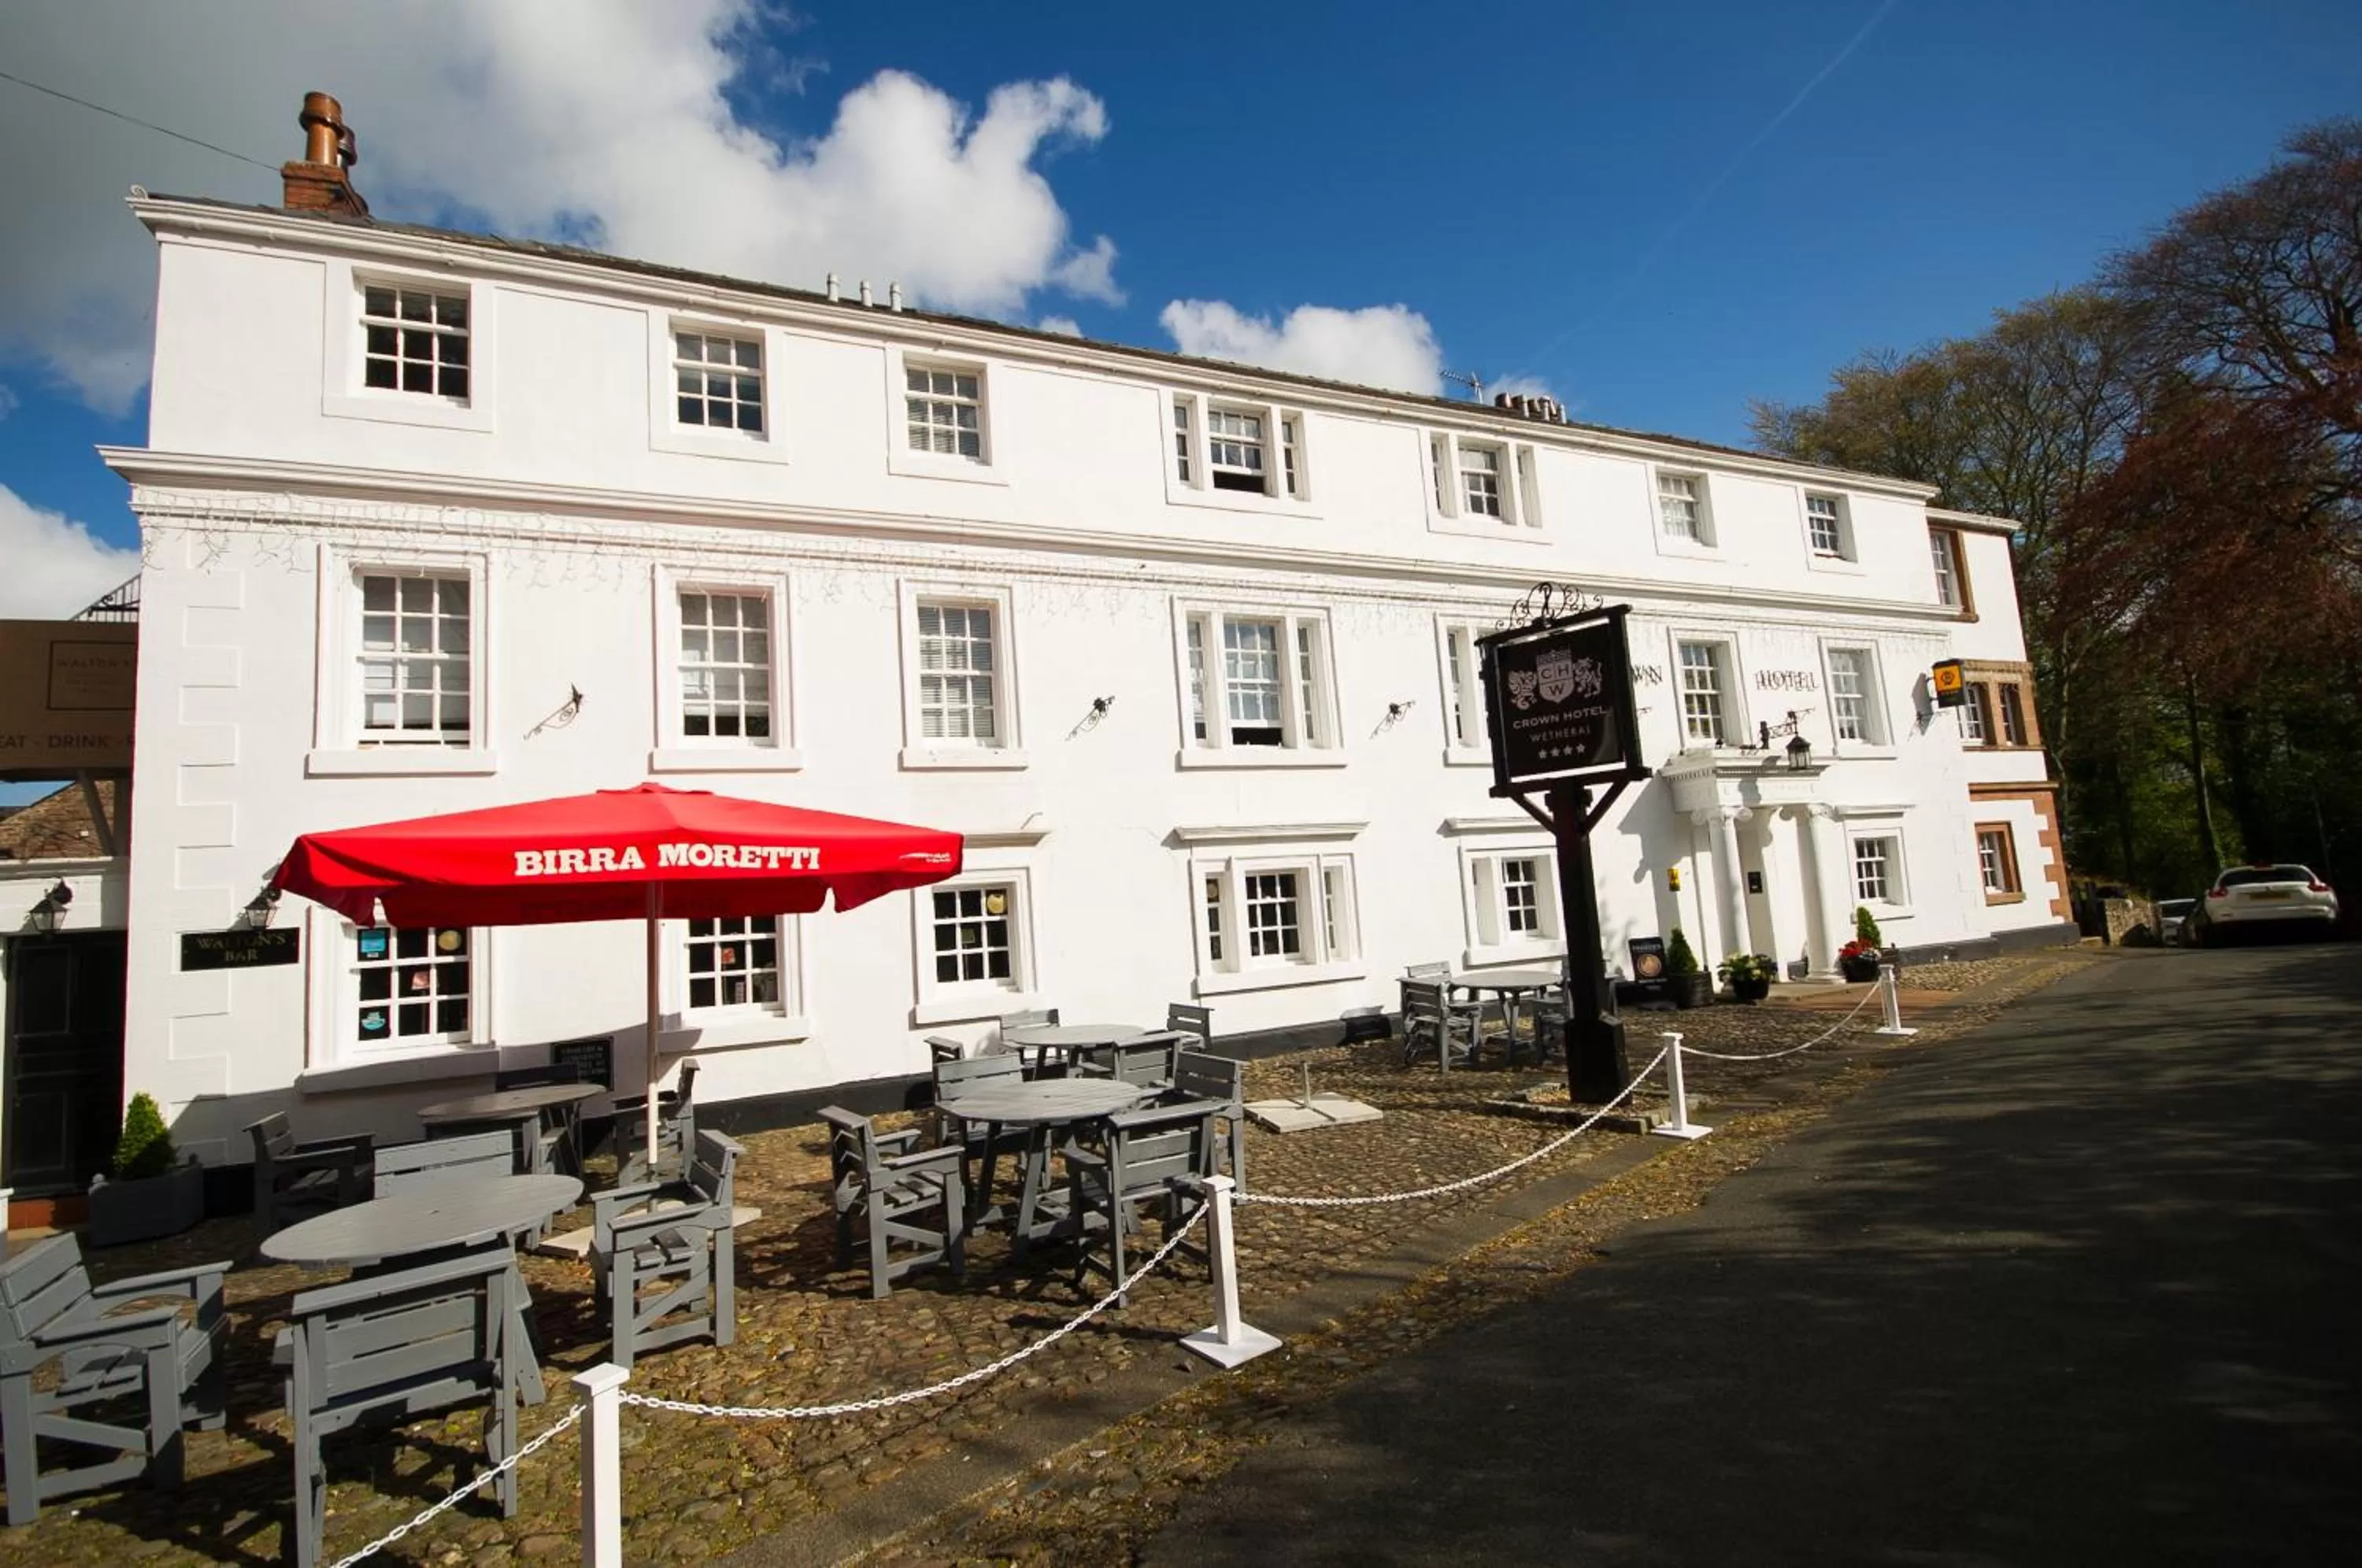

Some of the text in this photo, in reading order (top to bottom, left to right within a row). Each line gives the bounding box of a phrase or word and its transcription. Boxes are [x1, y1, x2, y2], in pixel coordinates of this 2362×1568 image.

[1541, 664, 1569, 679] C H
[1757, 668, 1820, 691] HOTEL
[1549, 683, 1564, 696] W
[1512, 705, 1609, 730] CROWN HOTEL
[47, 734, 109, 749] DRINK
[514, 843, 820, 876] BIRRA MORETTI
[224, 948, 259, 962] BAR
